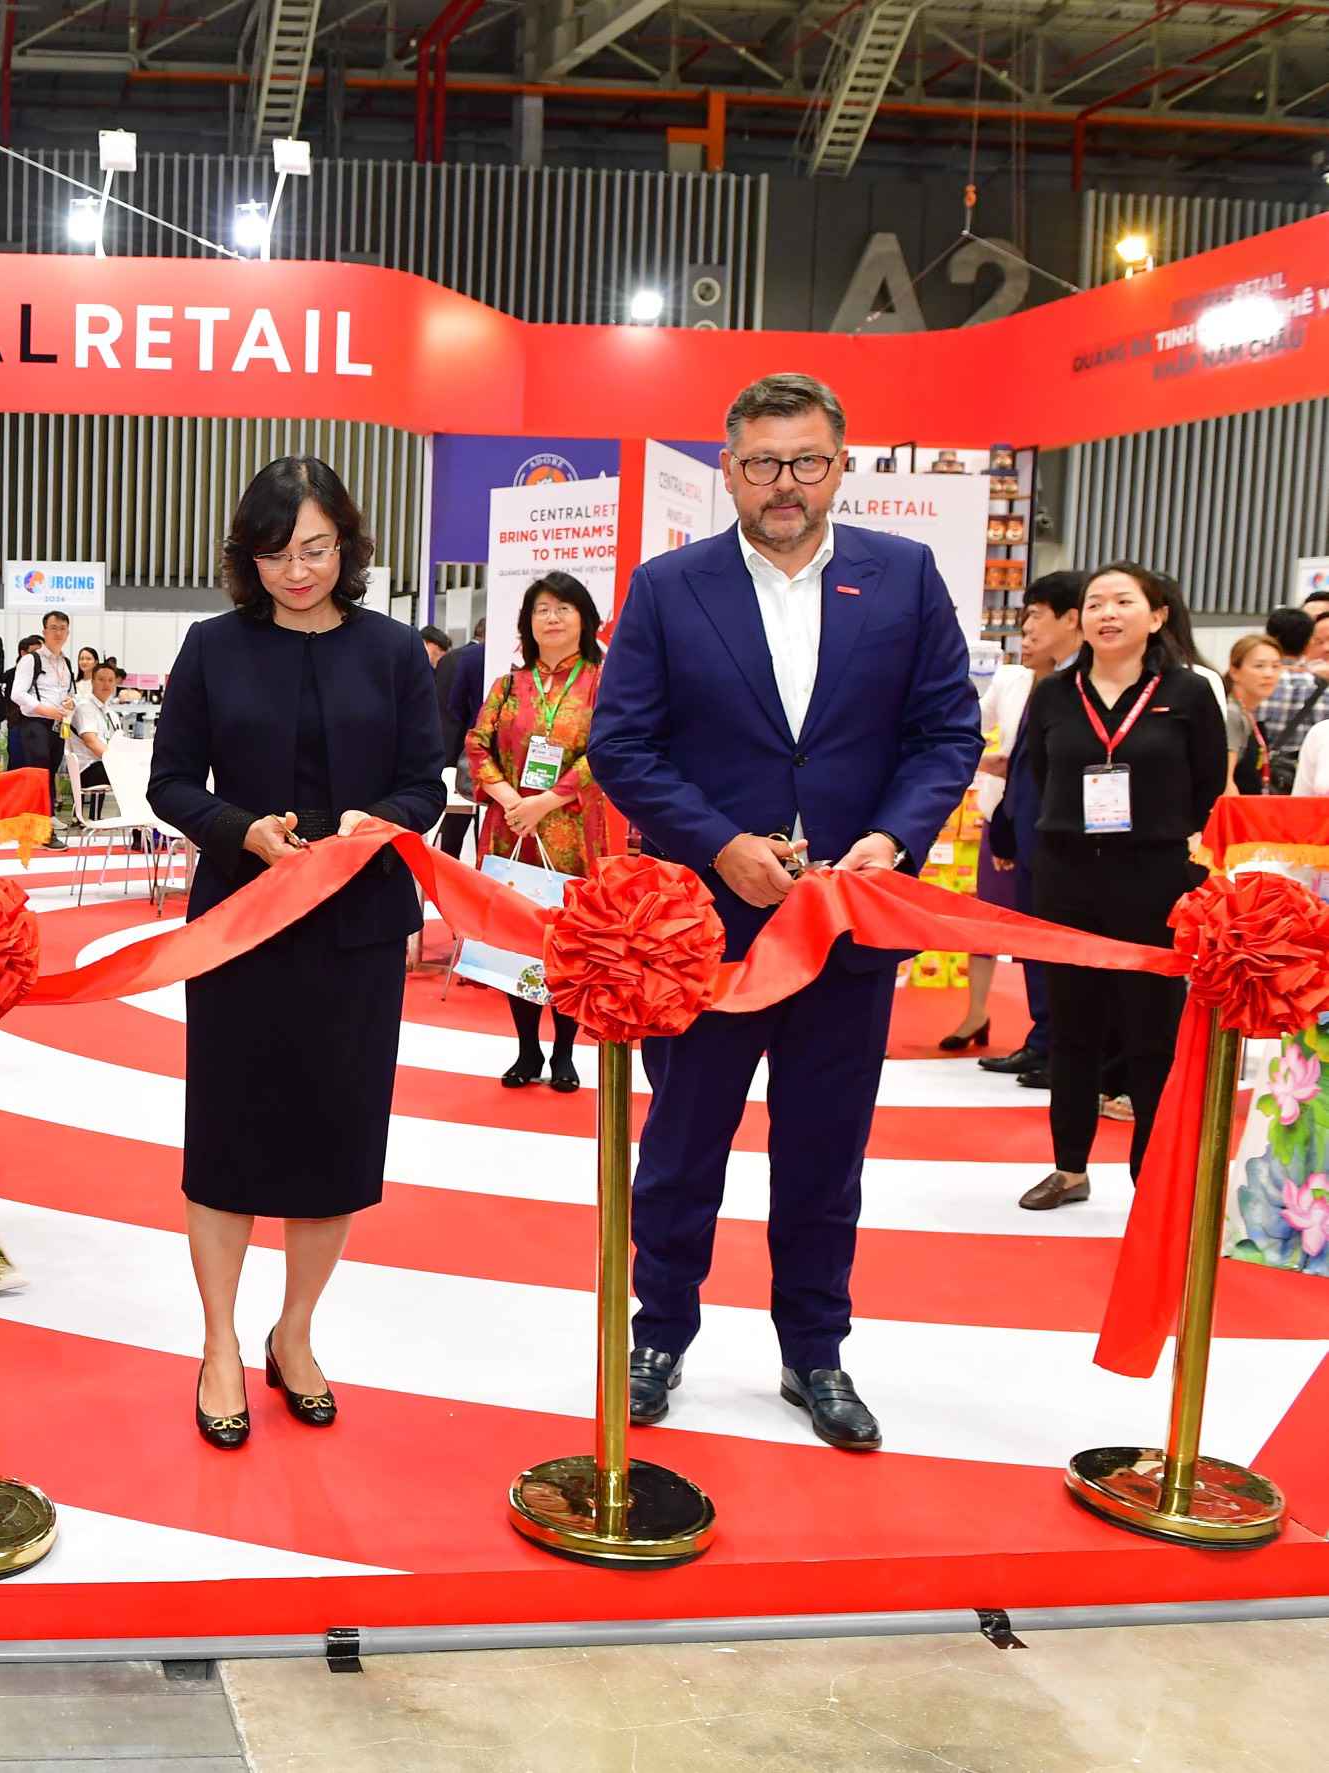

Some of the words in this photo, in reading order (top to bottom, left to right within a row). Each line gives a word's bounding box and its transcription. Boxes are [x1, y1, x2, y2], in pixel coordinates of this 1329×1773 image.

[530, 503, 617, 522] CENTRALRET
[830, 499, 939, 517] ALRETAIL
[499, 530, 538, 544] BRING
[542, 524, 614, 541] VIETNAM'S
[532, 548, 549, 560] TO
[554, 547, 578, 560] THE
[584, 545, 617, 558] WOR
